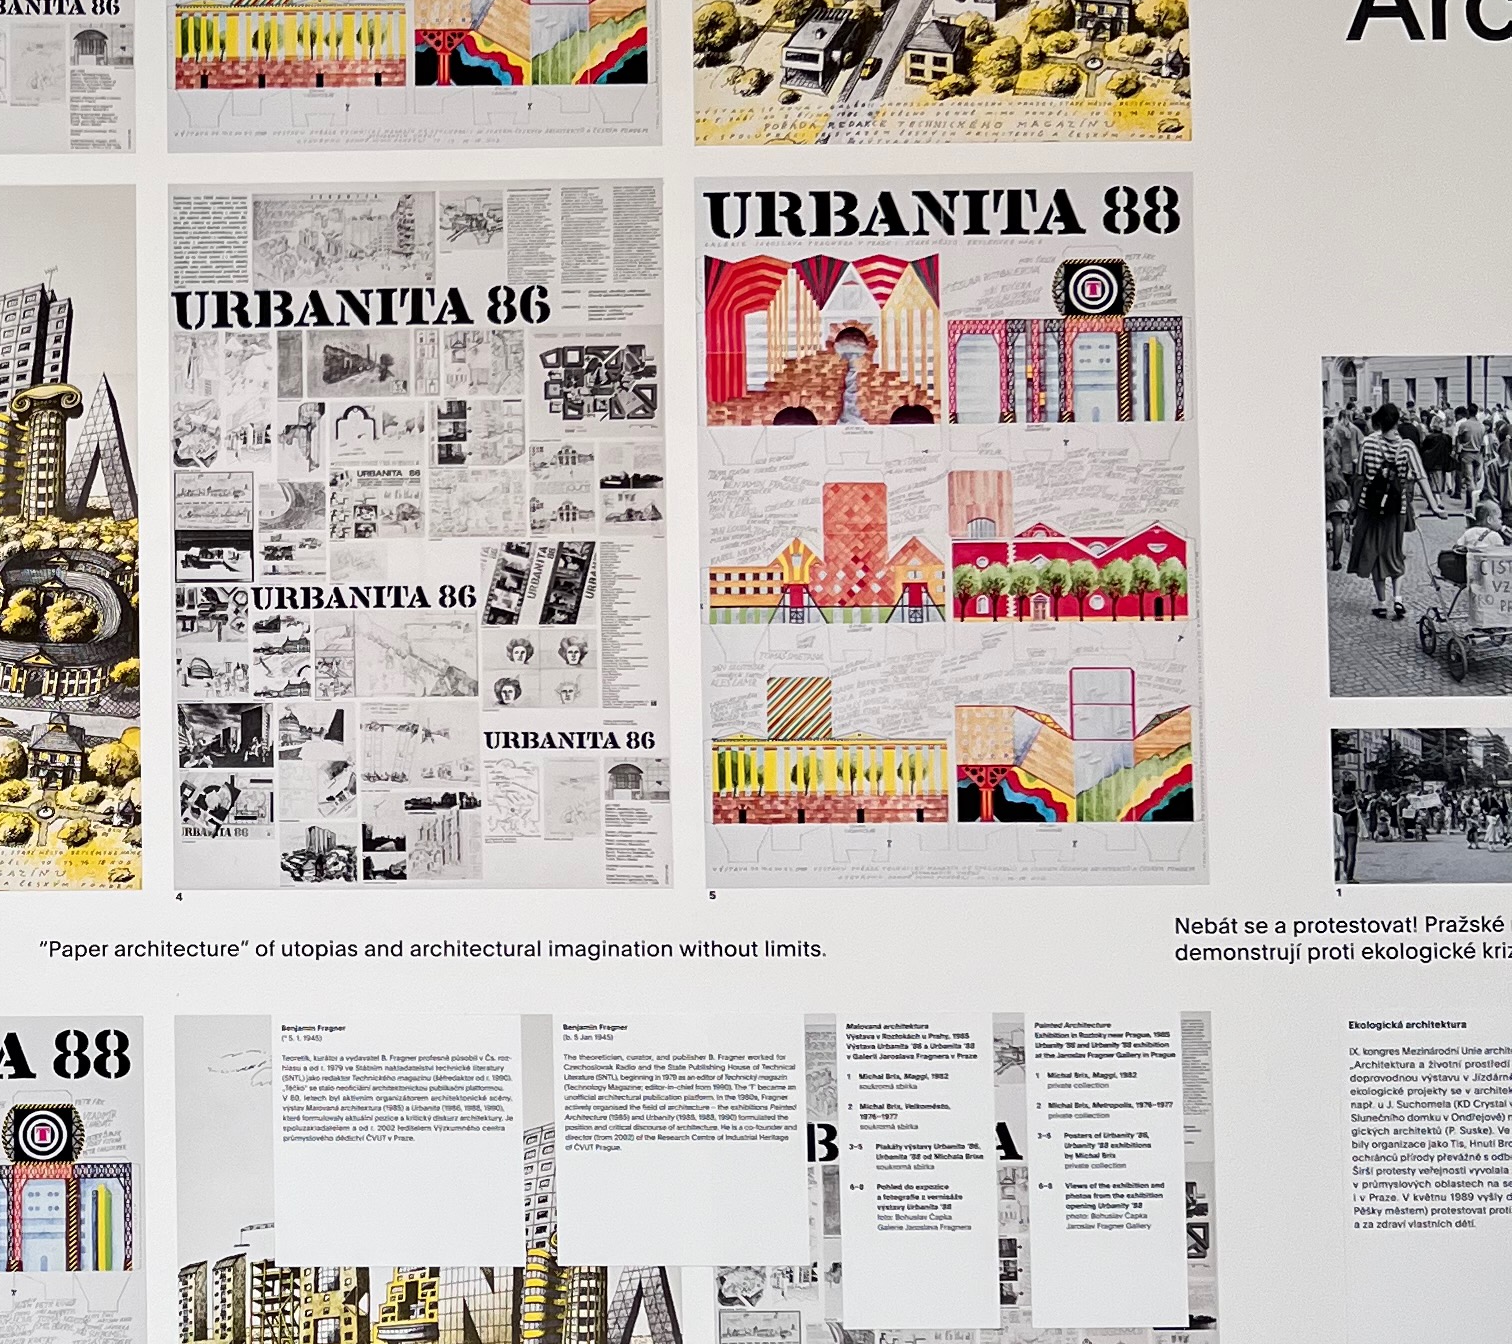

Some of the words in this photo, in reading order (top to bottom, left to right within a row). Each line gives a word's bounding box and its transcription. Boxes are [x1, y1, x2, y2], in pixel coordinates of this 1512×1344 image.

[703, 188, 1086, 239] URBANITA
[1102, 185, 1180, 234] 88
[170, 286, 474, 331] URBANITA
[487, 284, 550, 324] 86
[250, 585, 431, 609] URBANITA
[438, 584, 476, 607] 86
[483, 731, 621, 749] URBANITA
[626, 731, 655, 749] 86
[176, 893, 182, 901] 4
[710, 891, 716, 899] 5
[1175, 917, 1237, 934] Nebát
[1244, 921, 1268, 933] se
[1274, 921, 1286, 933] a
[1293, 916, 1417, 937] protestovat!
[1425, 915, 1504, 932] Pražské
[255, 940, 275, 956] of
[281, 940, 357, 960] utopias
[364, 940, 402, 956] and
[410, 940, 540, 957] architectural
[548, 940, 672, 960] imagination
[679, 940, 758, 957] without
[765, 940, 826, 957] limits.
[1175, 943, 1302, 965] demonstrují
[1308, 943, 1354, 963] proti
[1361, 941, 1475, 963] ekologické
[1348, 1020, 1403, 1031] Ekologická
[1405, 1020, 1466, 1028] architektura
[53, 1029, 130, 1079] 88
